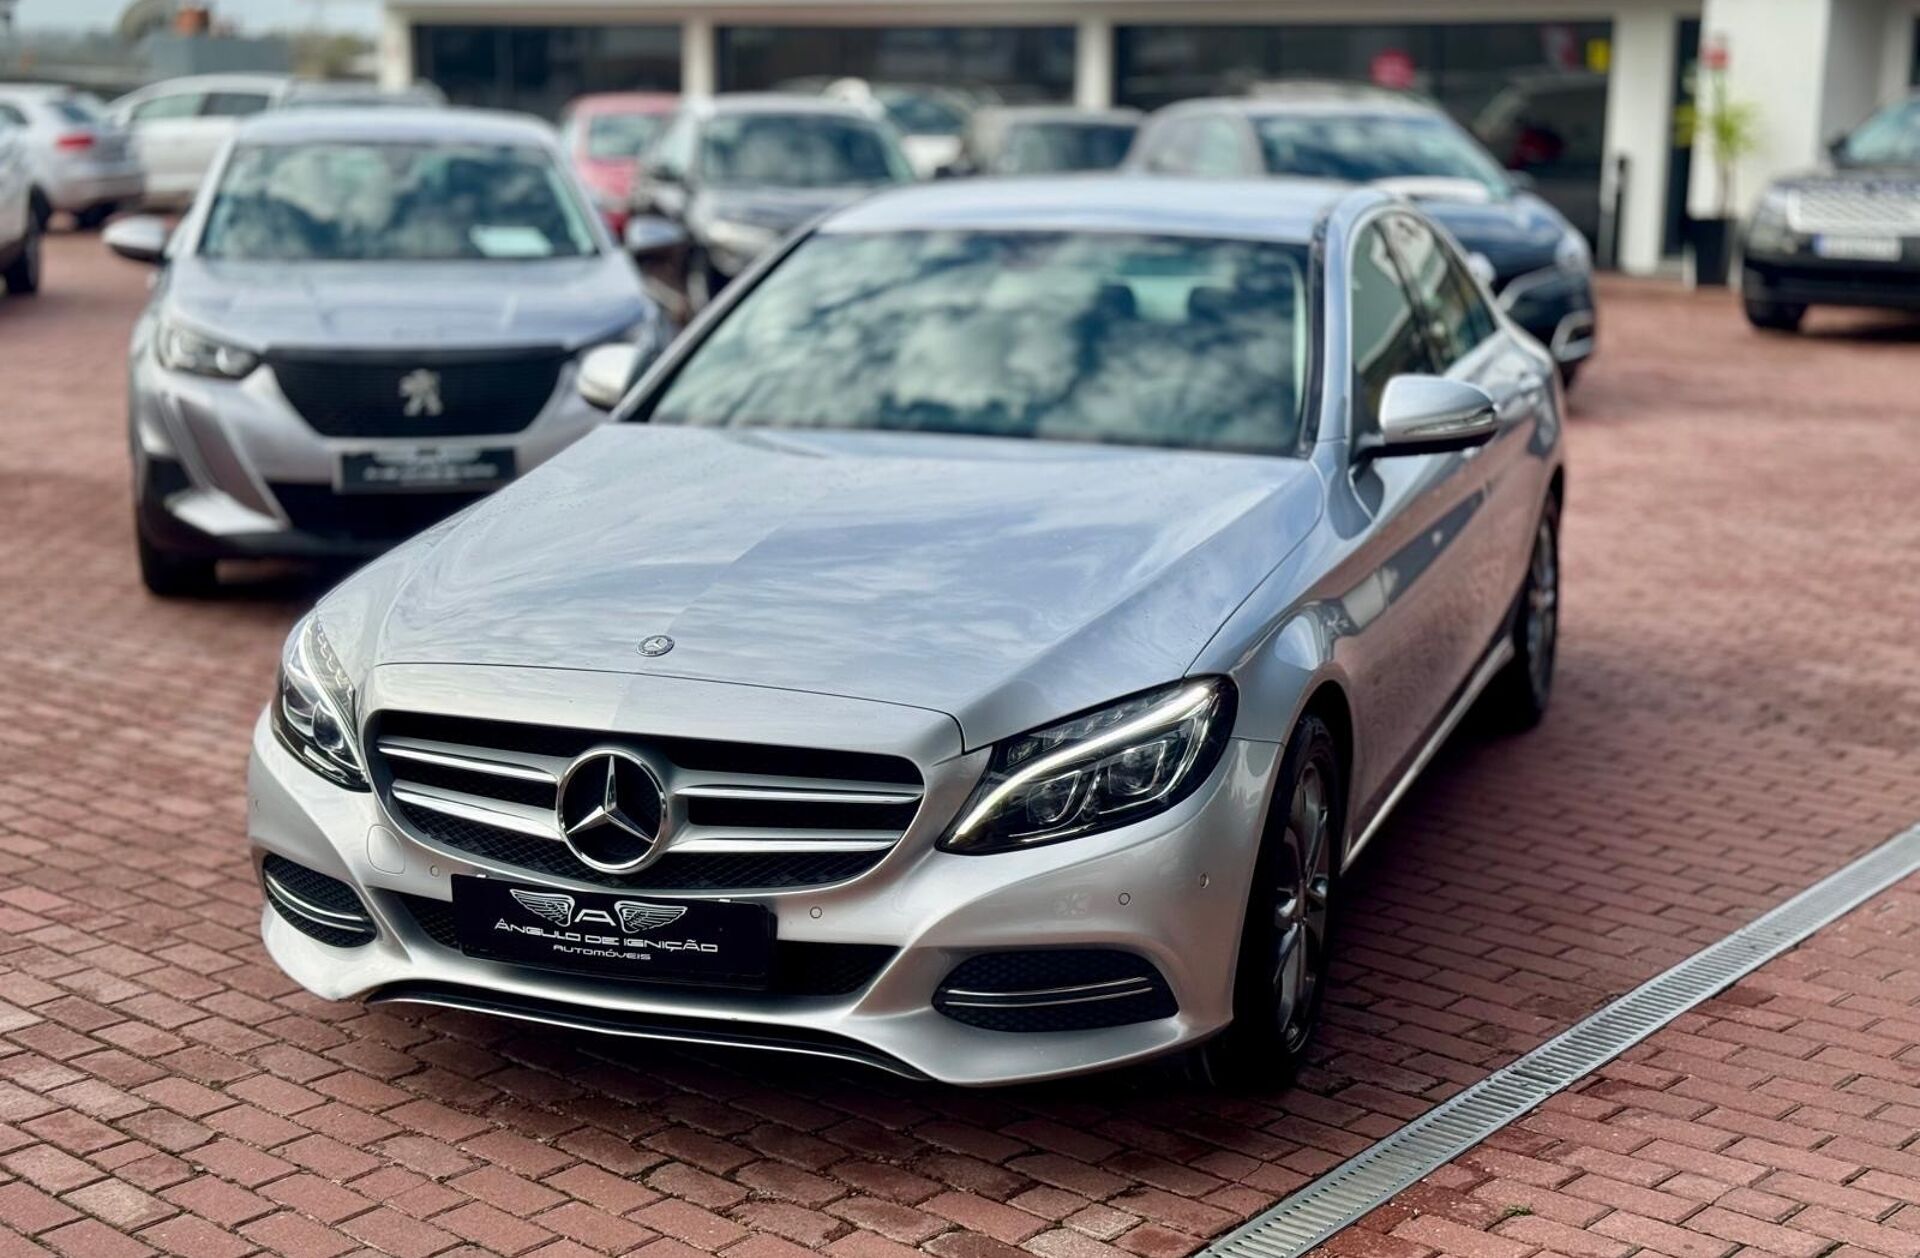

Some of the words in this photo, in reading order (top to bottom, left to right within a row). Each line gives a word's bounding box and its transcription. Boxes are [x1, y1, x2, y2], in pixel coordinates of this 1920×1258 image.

[574, 909, 617, 927] A
[494, 918, 581, 942] ÂNGULO
[585, 934, 619, 946] DE
[624, 938, 718, 953] IGNIÇÃO
[553, 944, 651, 960] AUTOMÓVEIS
